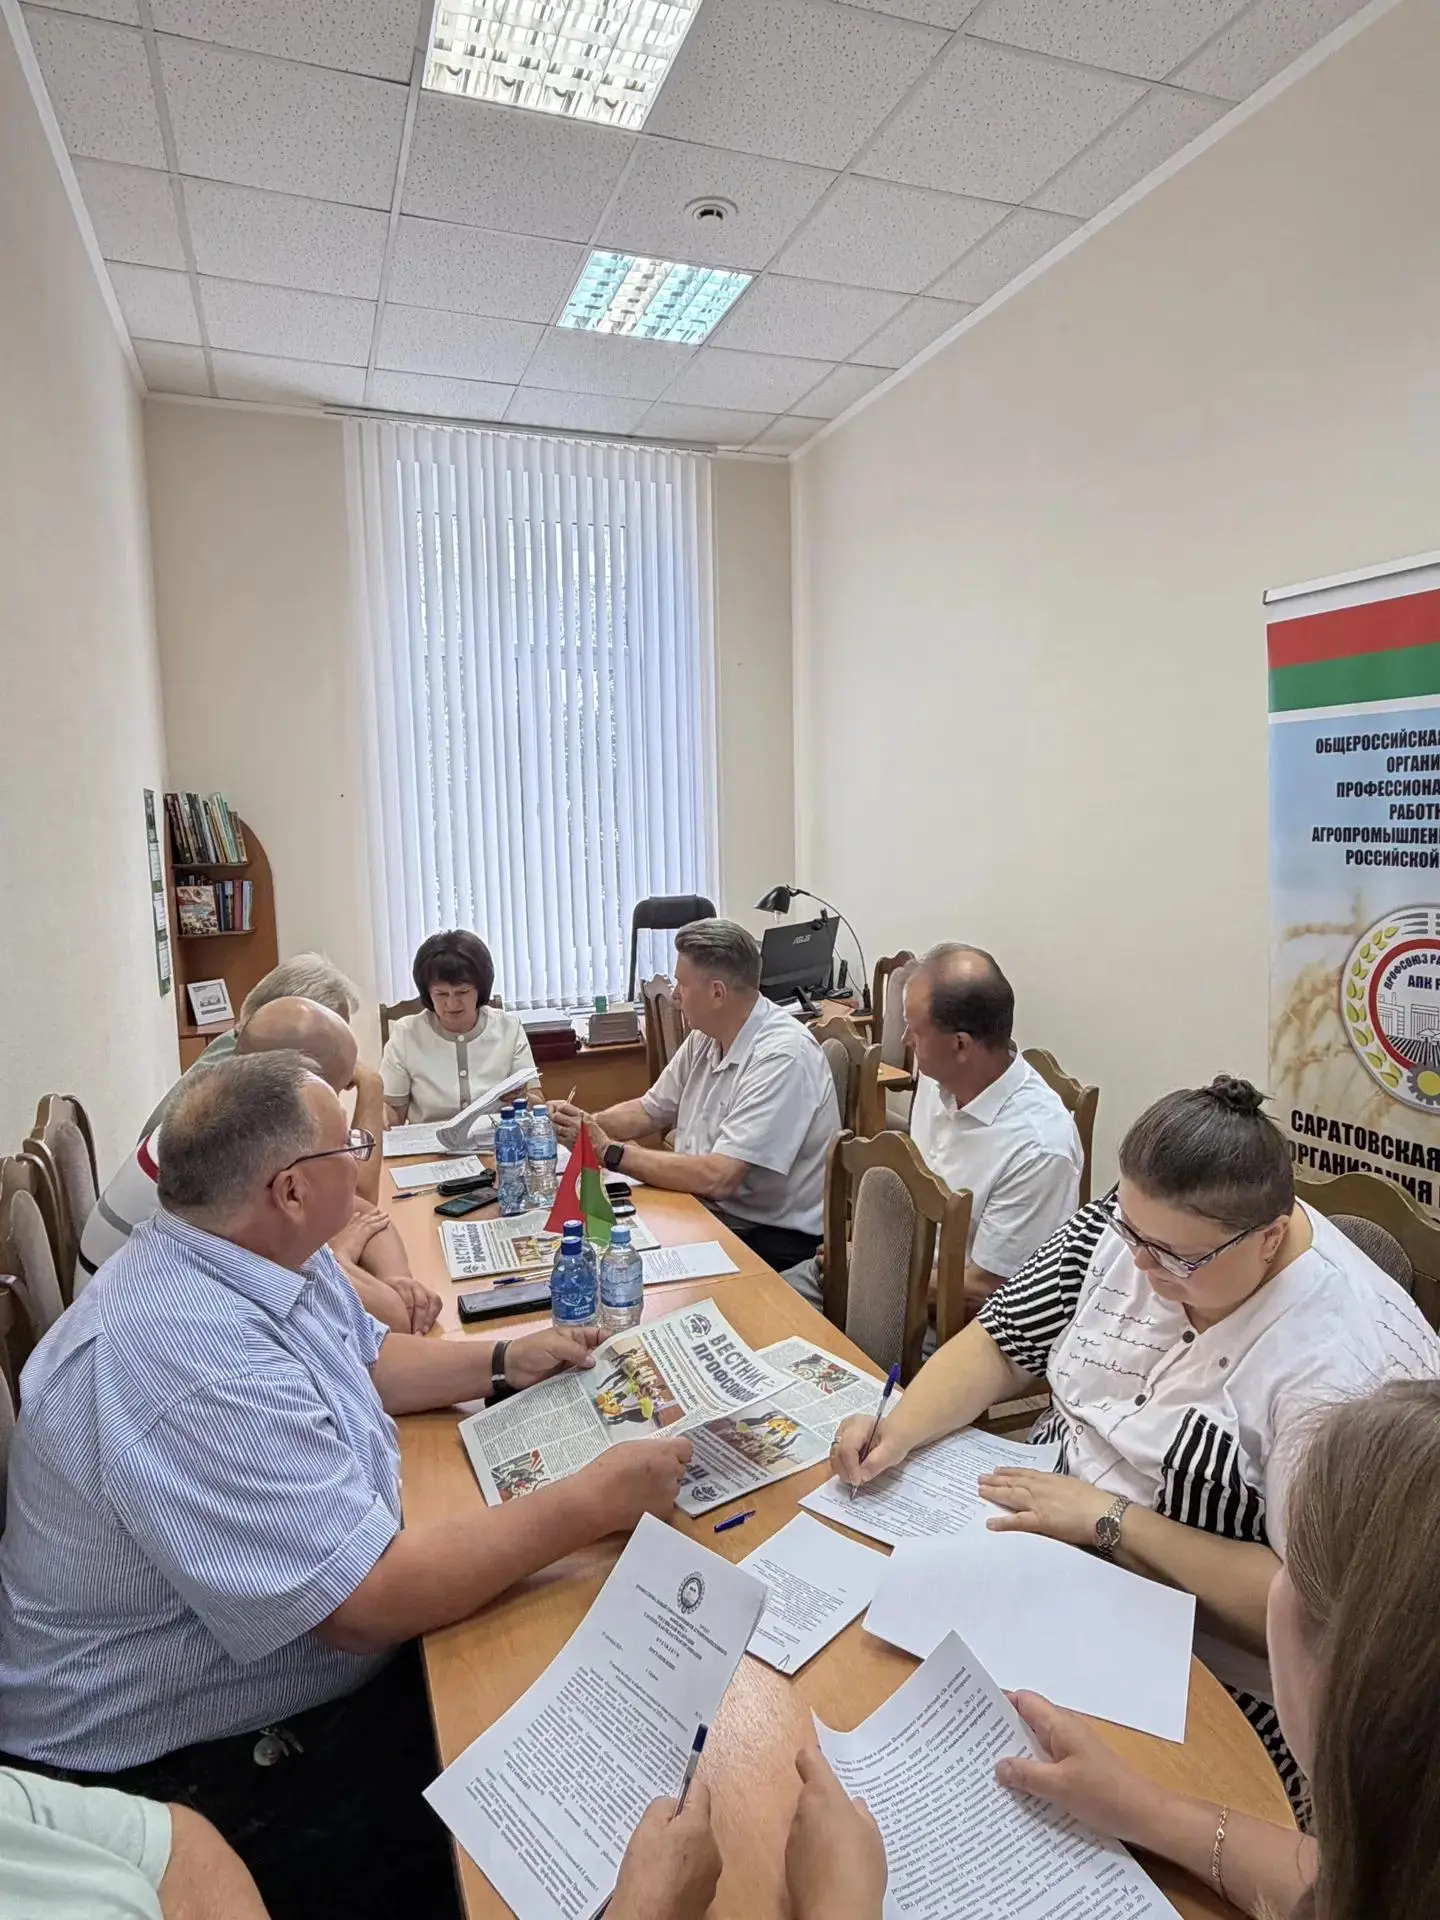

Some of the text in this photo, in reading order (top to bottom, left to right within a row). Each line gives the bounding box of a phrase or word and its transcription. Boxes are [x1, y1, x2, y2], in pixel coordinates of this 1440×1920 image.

[1315, 728, 1440, 755] ОБЩЕРОССИЙСКА
[1312, 826, 1440, 845] АГРОПРОМЫШЛЕН
[1345, 848, 1440, 869] РОССИЙСКОЙ
[1384, 953, 1428, 990] ПРОФСОЮЗ
[1407, 974, 1433, 990] АПК
[1291, 1109, 1440, 1173] САРАТОВСКАЯ
[706, 1332, 770, 1389] ВЕСТНИК
